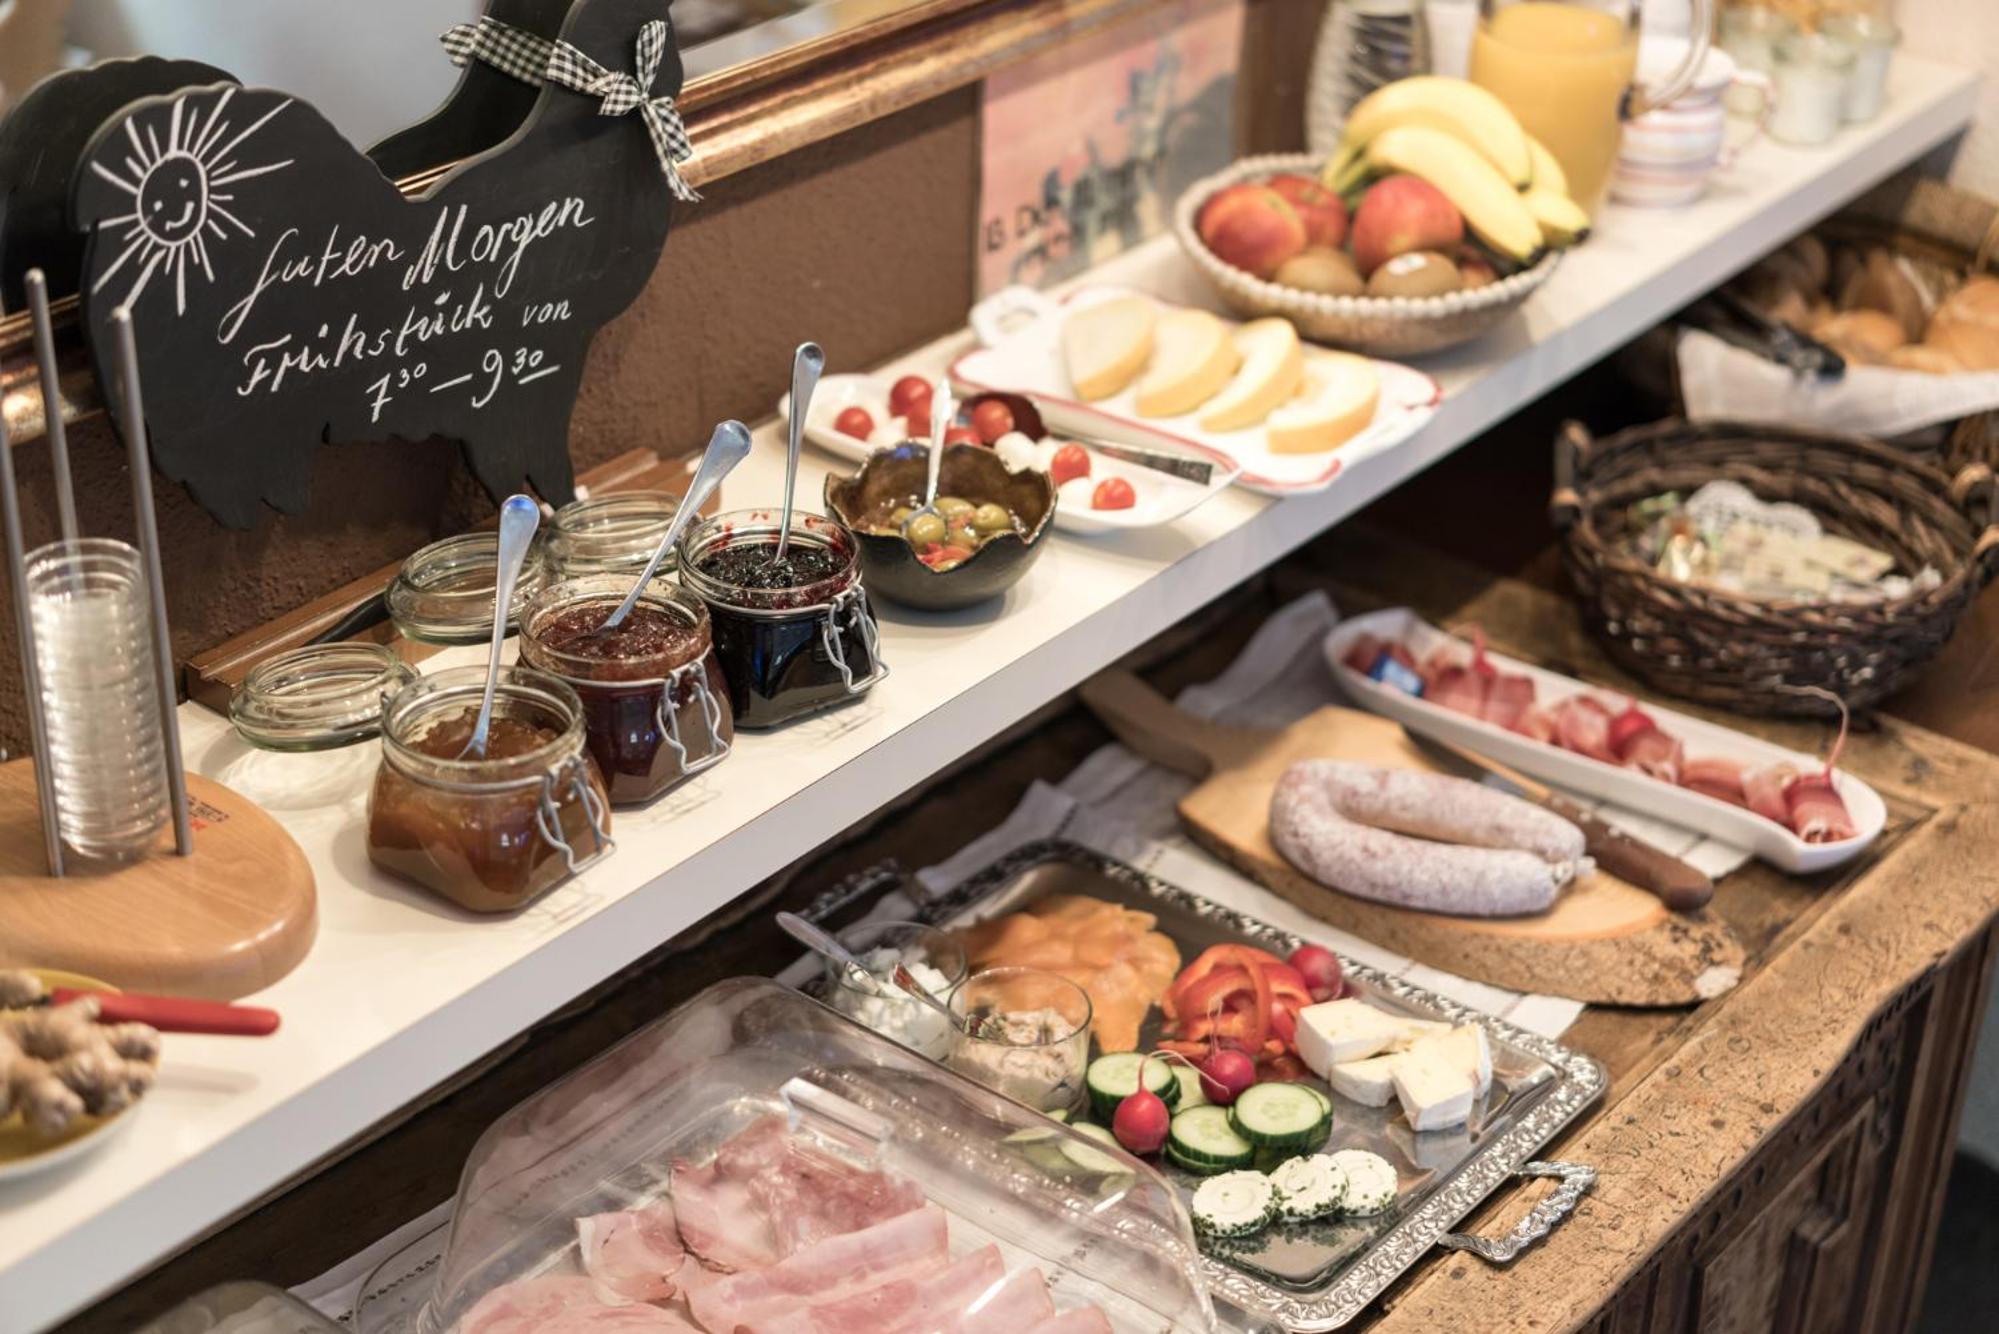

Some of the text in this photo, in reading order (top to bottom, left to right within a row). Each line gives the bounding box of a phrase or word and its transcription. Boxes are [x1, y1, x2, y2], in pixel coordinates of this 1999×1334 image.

[218, 198, 595, 345] Guten Morgen
[236, 283, 572, 397] Frühstück von
